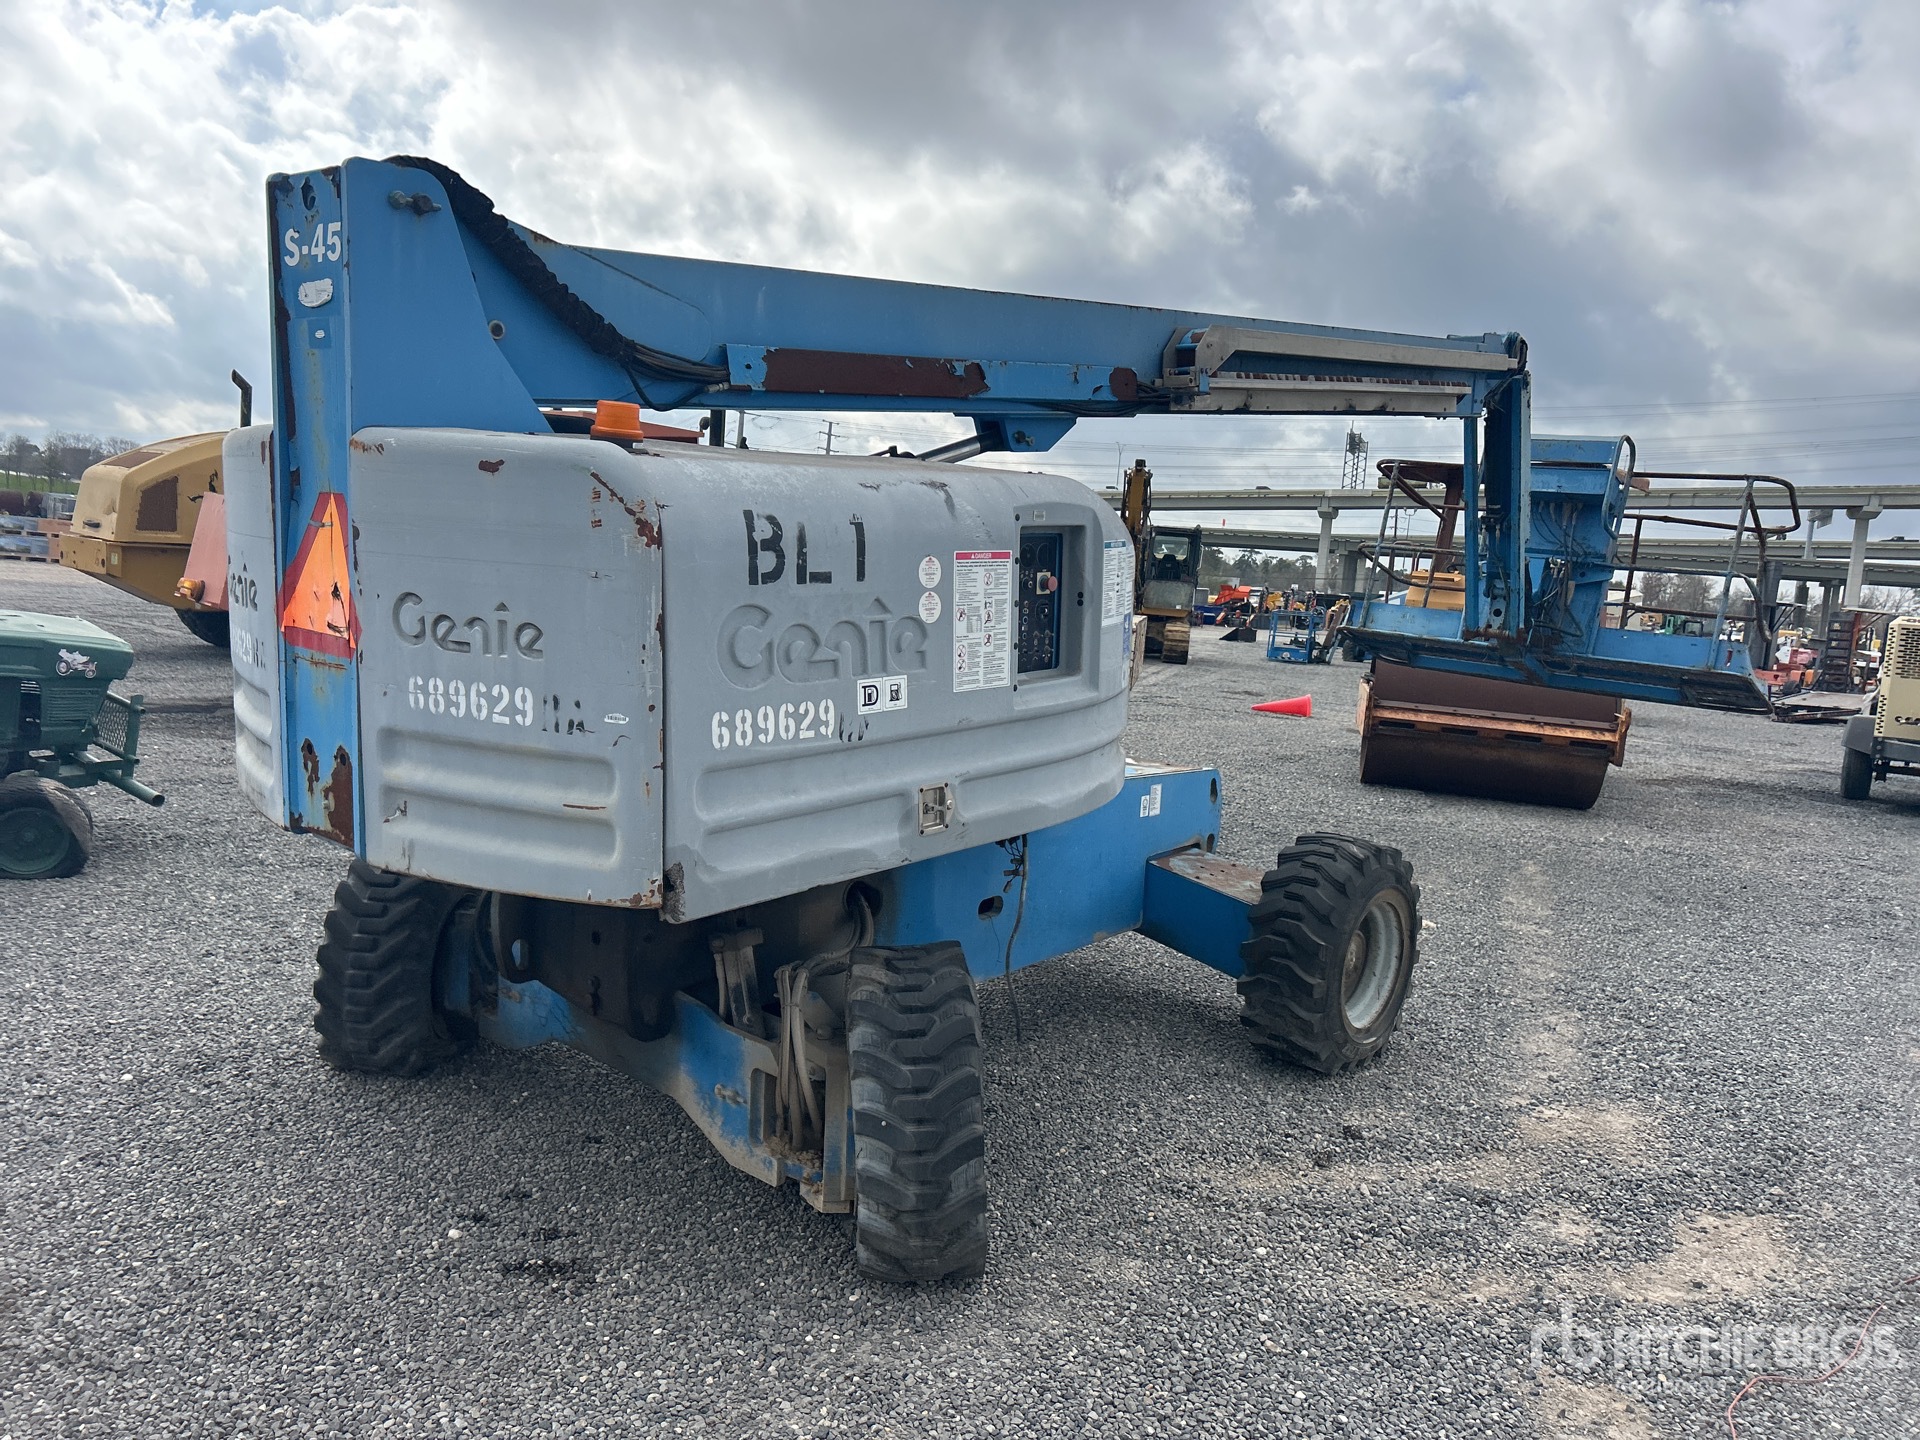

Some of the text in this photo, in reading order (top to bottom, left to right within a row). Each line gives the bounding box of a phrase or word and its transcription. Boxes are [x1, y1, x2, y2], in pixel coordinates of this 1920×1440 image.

[284, 221, 342, 267] S-45
[228, 555, 259, 612] enie
[391, 591, 544, 662] Genie
[716, 597, 928, 691] Genie
[408, 675, 534, 727] 689629
[711, 698, 836, 751] 689629
